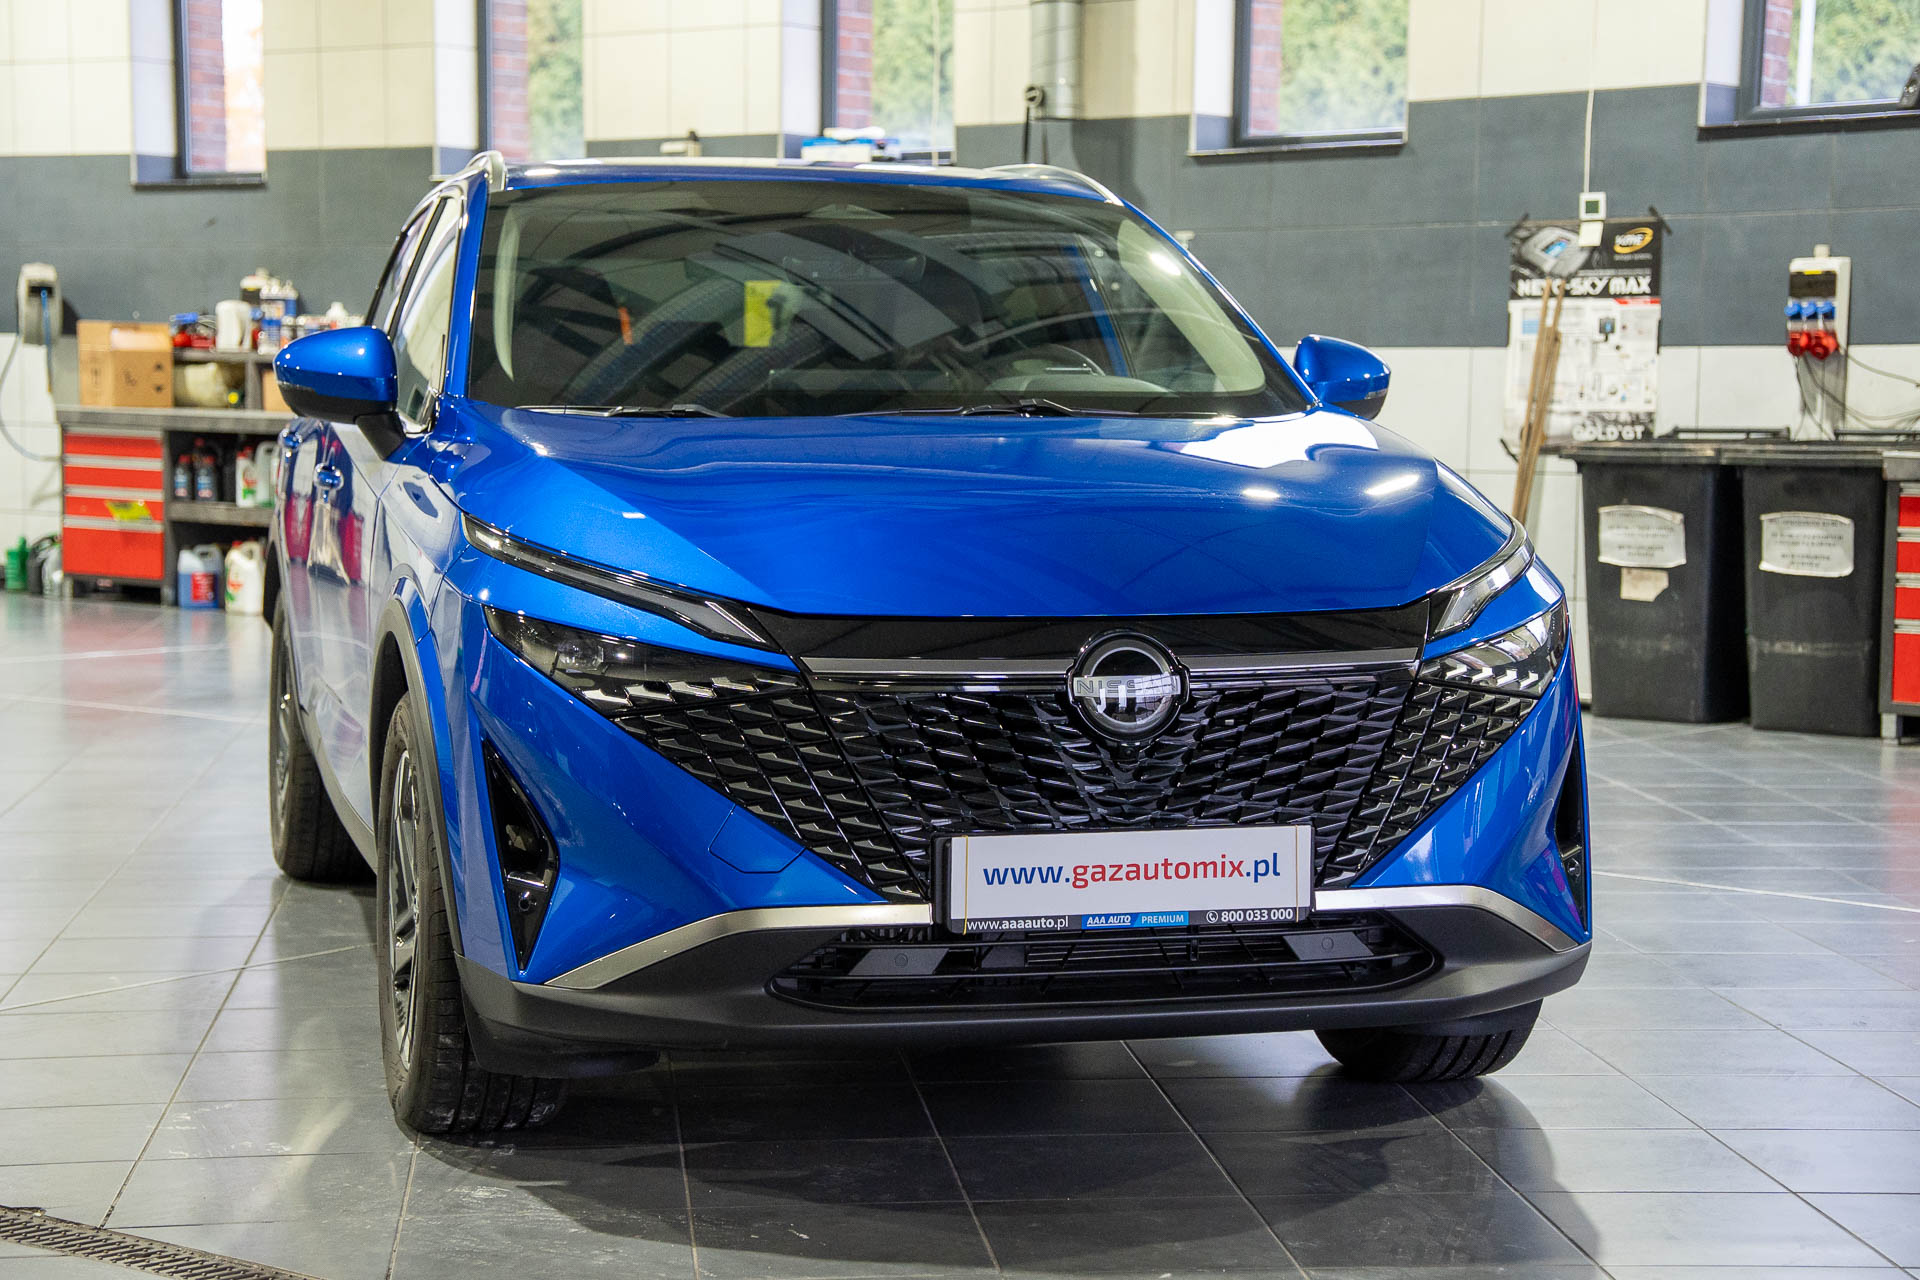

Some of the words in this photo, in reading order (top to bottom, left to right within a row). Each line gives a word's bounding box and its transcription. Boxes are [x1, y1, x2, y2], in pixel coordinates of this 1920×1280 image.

[1609, 275, 1652, 295] MAX
[982, 852, 1281, 889] www.gazautomix.pl
[1086, 916, 1106, 925] AAA
[1108, 915, 1131, 924] AUTO
[1141, 914, 1185, 924] PREMIUM
[1221, 911, 1243, 922] 800
[1246, 910, 1268, 921] 033
[1271, 908, 1293, 920] 000
[967, 916, 1069, 931] www.aaaauto.pl
